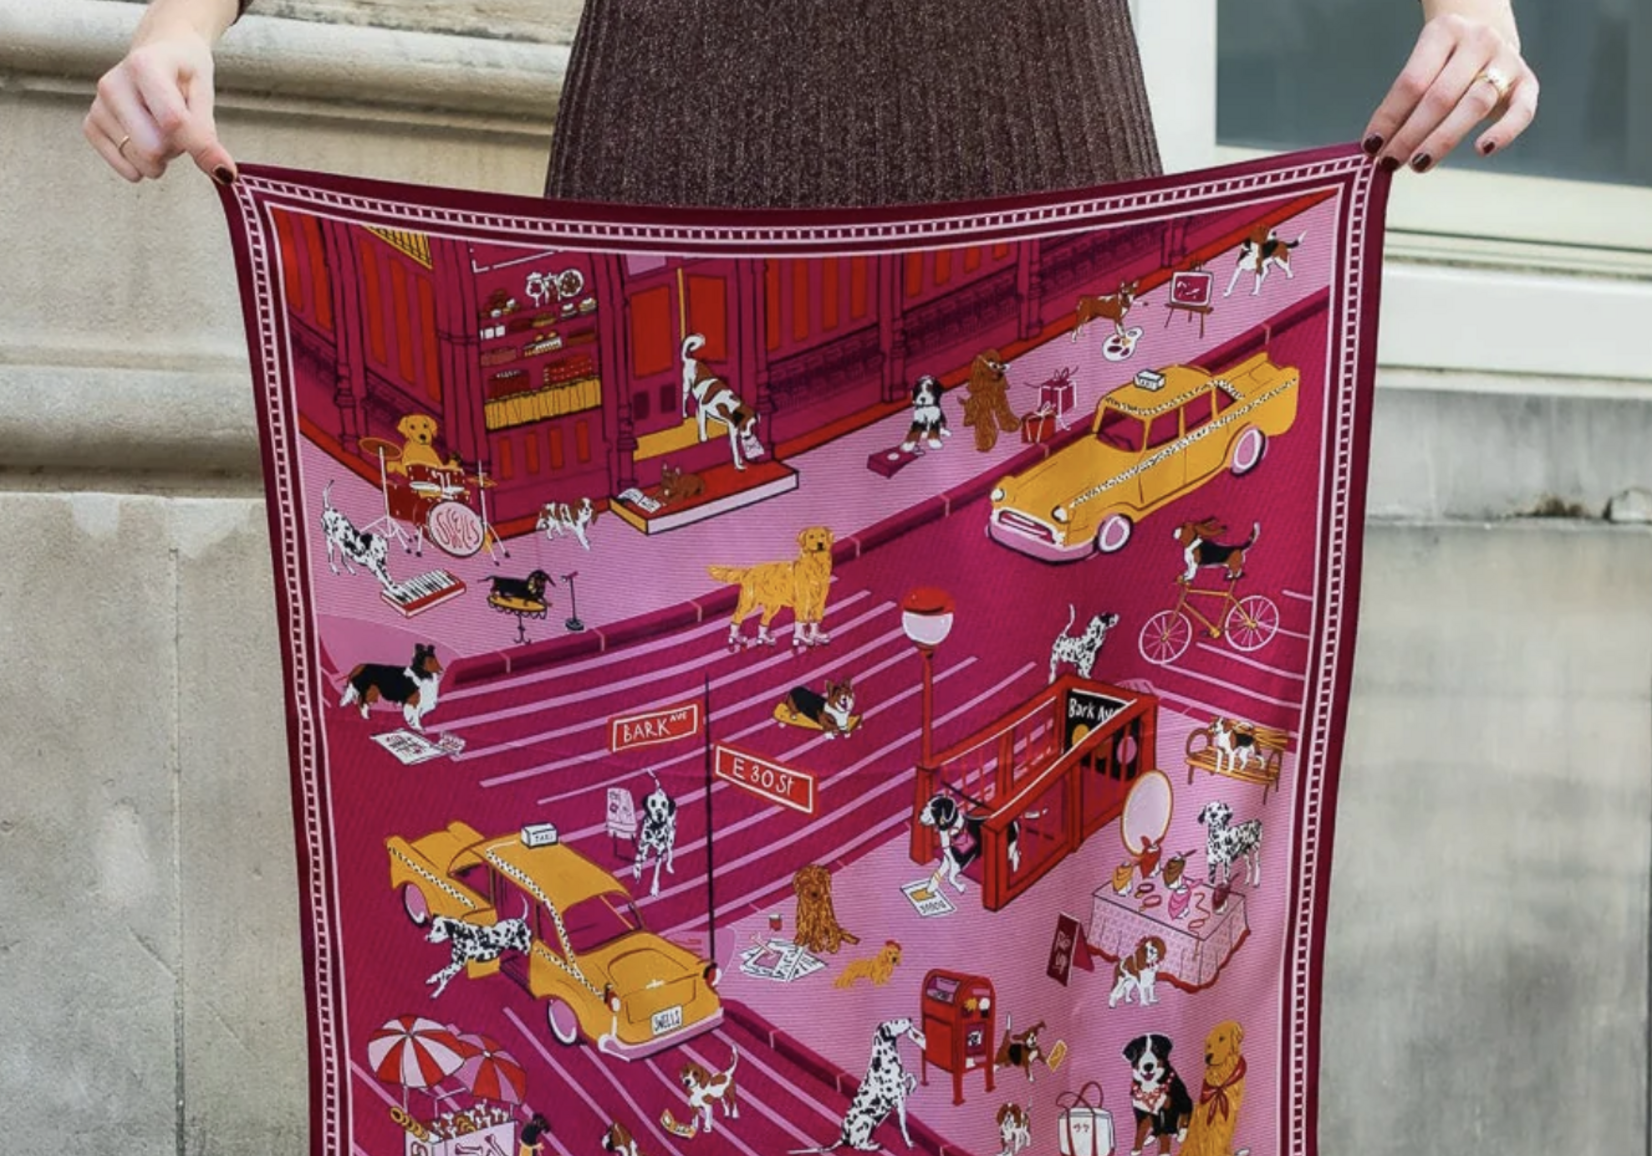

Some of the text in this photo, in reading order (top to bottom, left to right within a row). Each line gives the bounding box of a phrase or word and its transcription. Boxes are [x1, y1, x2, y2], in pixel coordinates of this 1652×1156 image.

[1068, 698, 1095, 719] Bark
[624, 711, 687, 743] BARK AVE
[733, 757, 794, 797] E 30 St
